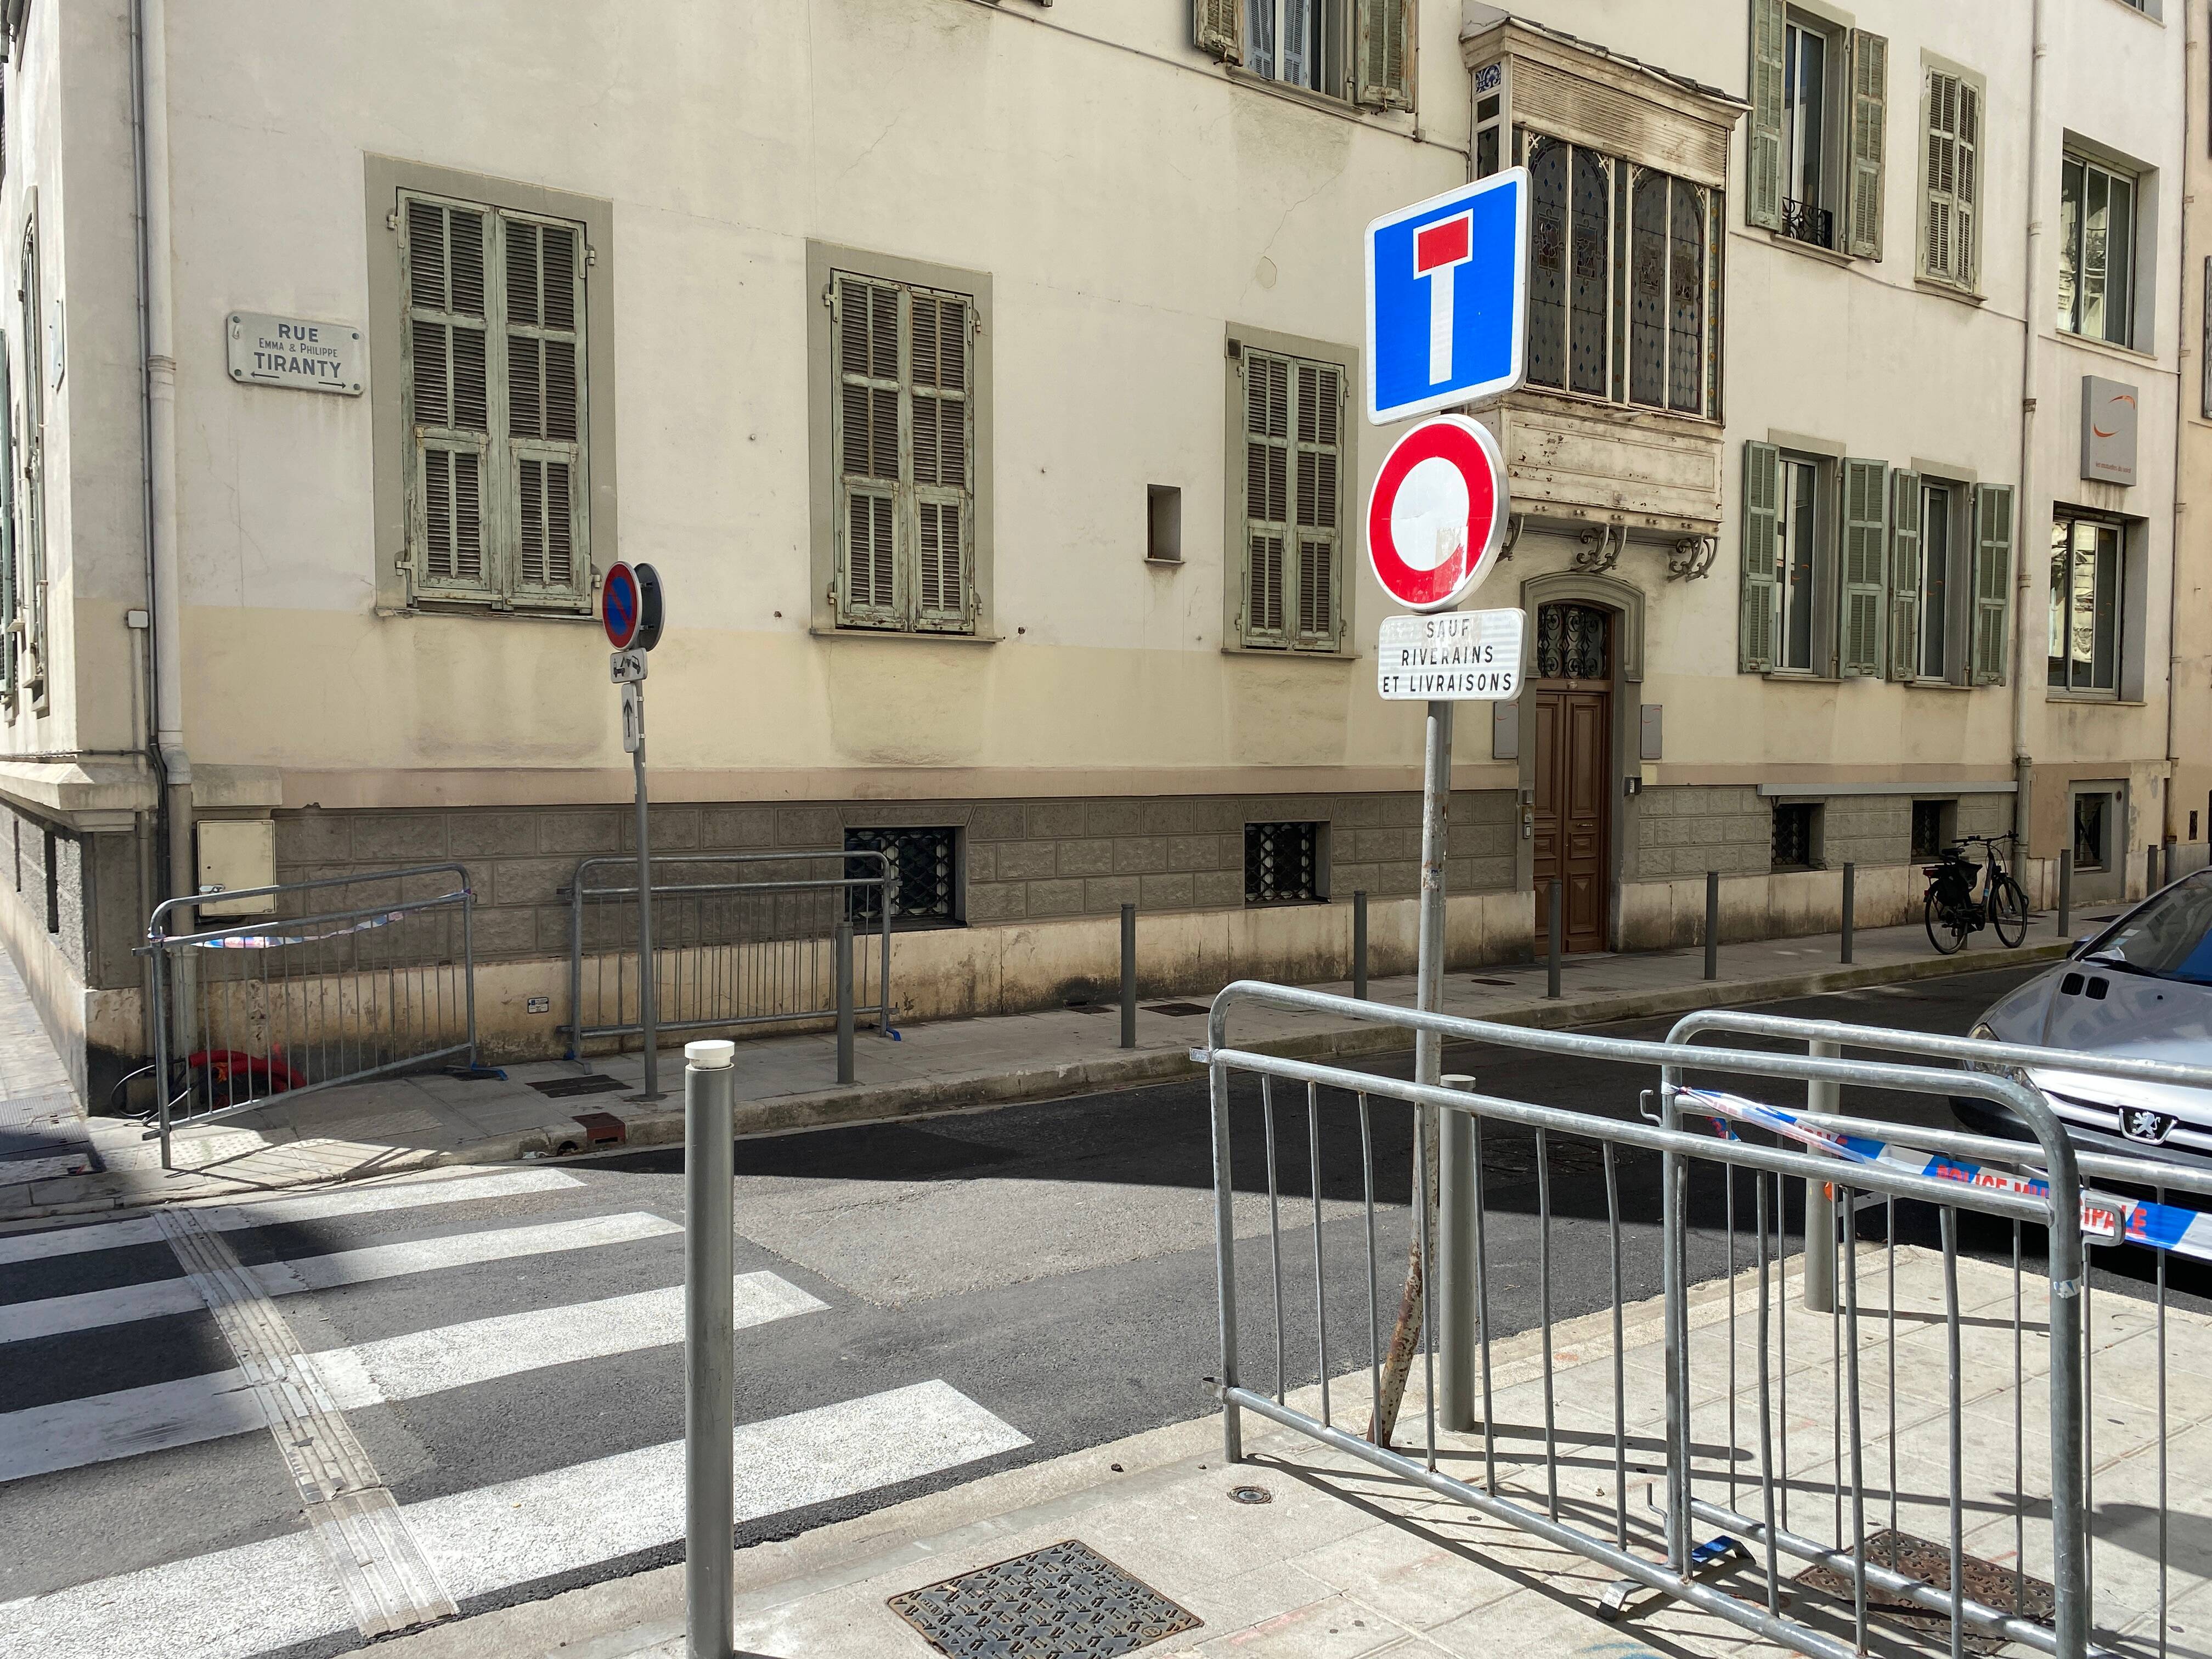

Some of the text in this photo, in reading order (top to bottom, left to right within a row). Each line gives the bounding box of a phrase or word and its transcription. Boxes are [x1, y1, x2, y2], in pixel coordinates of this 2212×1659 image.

[278, 324, 318, 342] RUE
[259, 338, 337, 357] EMMA & PHILIPPE
[253, 352, 341, 378] TIRANTY
[1426, 619, 1470, 638] SAUF
[1402, 645, 1493, 666] RIVERAINS
[1383, 673, 1512, 693] ET LIVRAISONS
